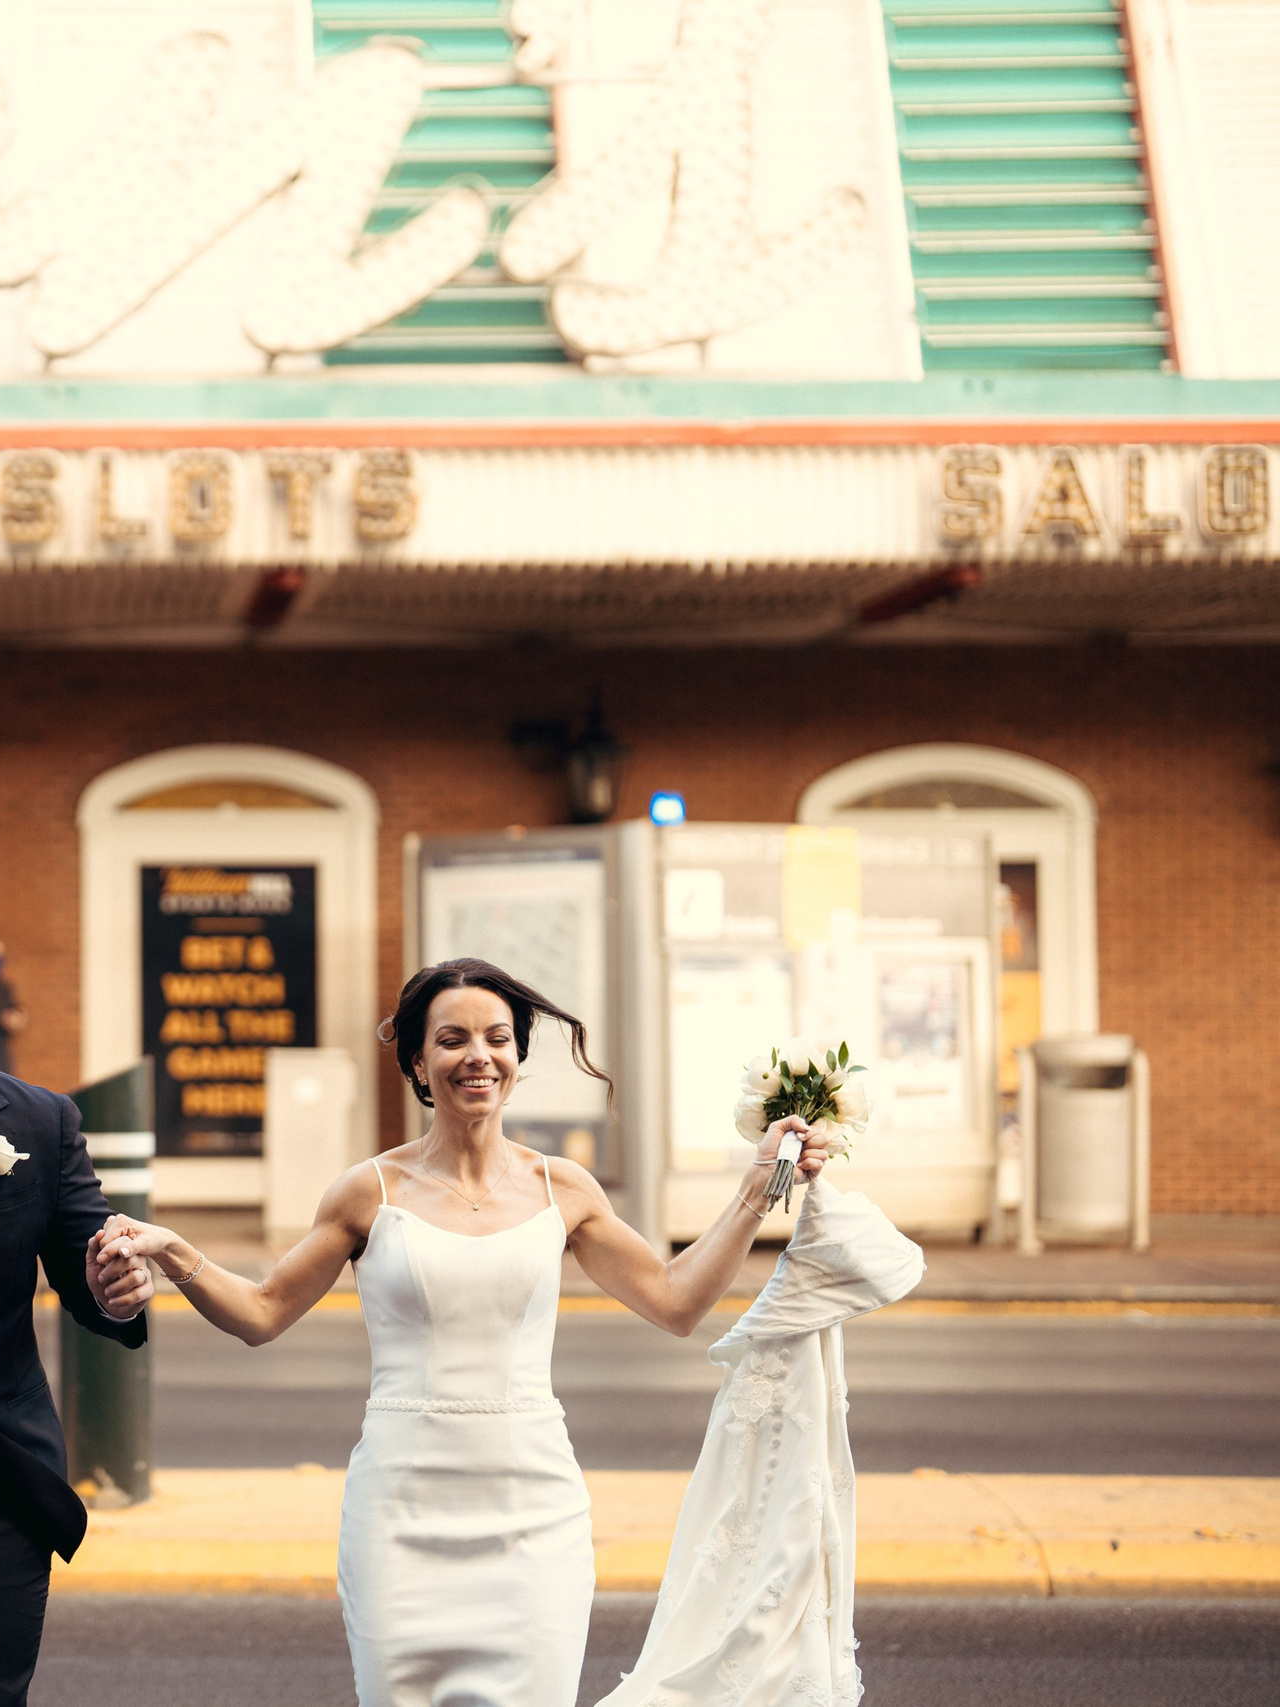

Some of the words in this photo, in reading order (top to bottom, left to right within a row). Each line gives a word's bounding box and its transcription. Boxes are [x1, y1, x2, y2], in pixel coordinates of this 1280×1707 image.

[940, 445, 1271, 538] SALO
[180, 935, 245, 970] BET
[160, 971, 286, 1006] WATCH
[160, 1009, 225, 1044] ALL
[224, 1009, 294, 1044] THE
